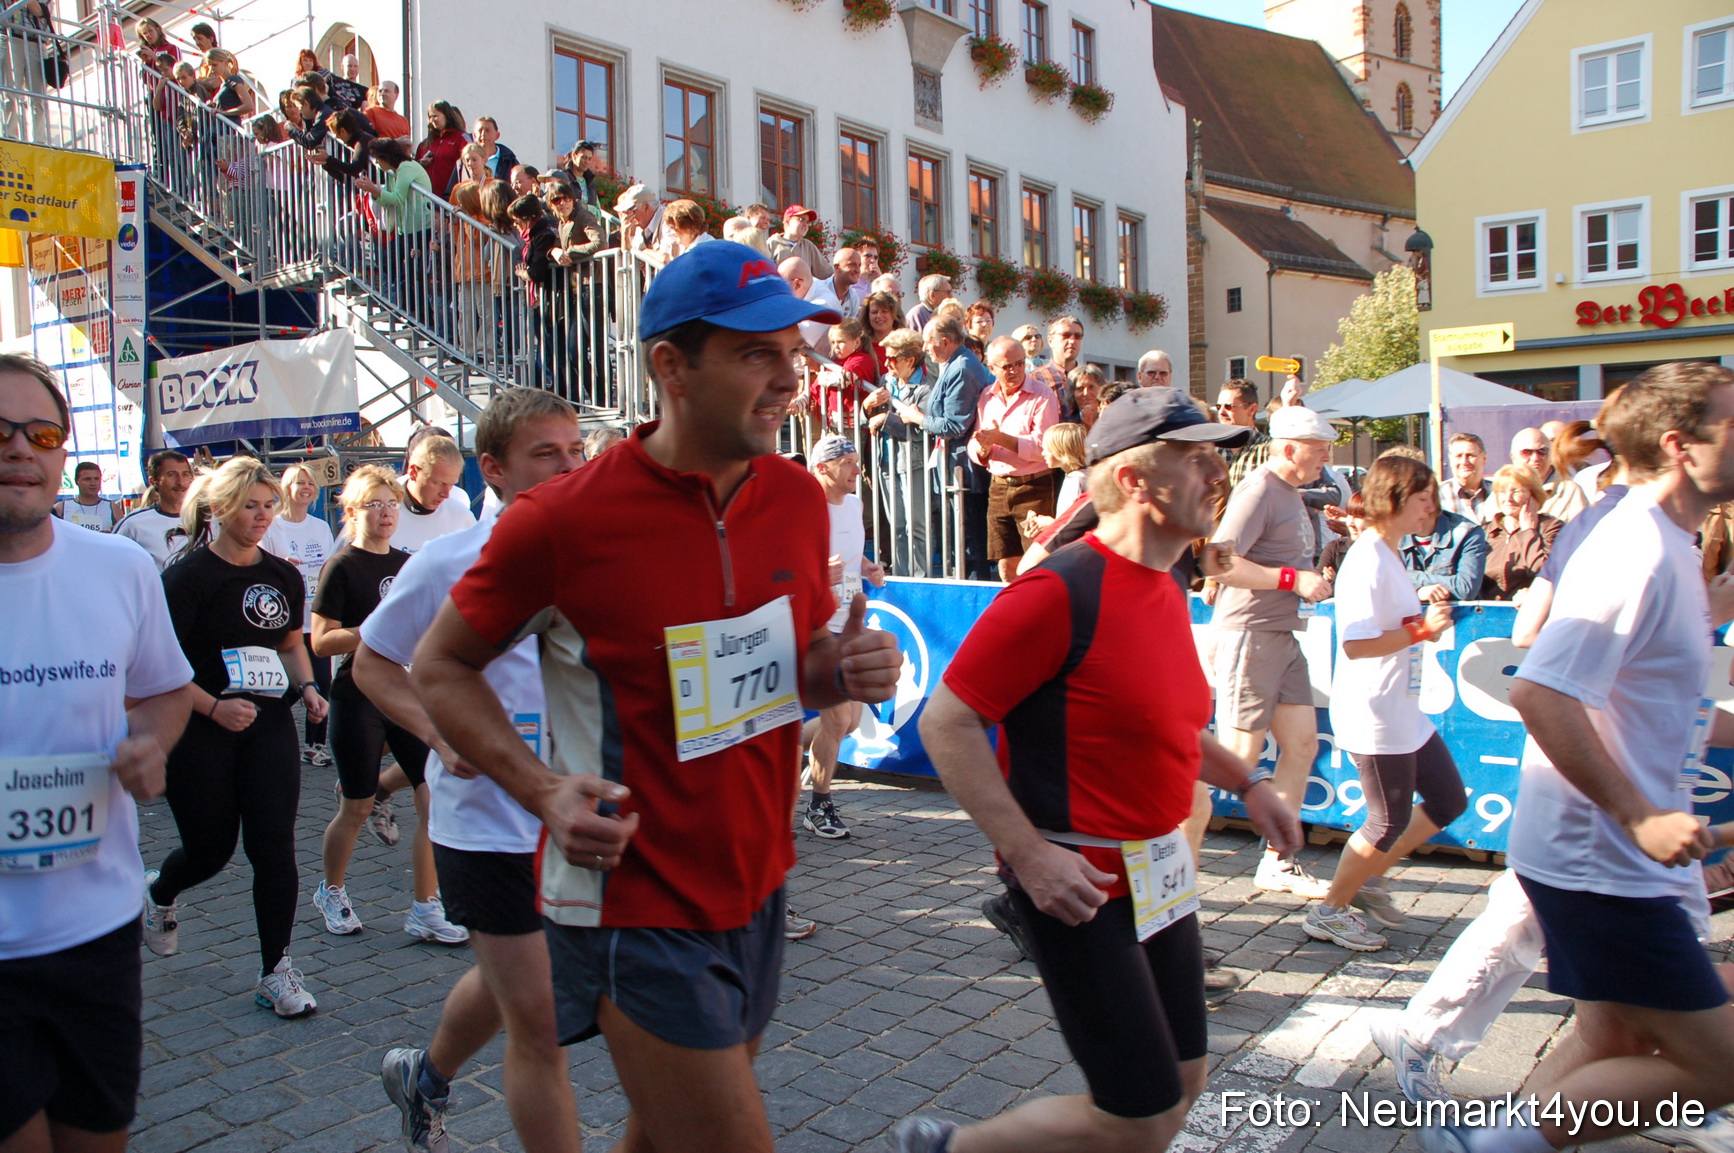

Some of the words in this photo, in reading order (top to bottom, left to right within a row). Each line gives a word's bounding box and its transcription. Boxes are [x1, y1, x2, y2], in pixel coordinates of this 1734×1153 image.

[14, 191, 79, 210] Stadtlauf
[61, 286, 87, 301] MERZ
[1576, 300, 1634, 327] Der
[159, 361, 259, 415] BOCK
[715, 627, 770, 659] Jürgen
[242, 651, 271, 663] Tamara
[0, 660, 117, 687] bodyswife.de
[247, 671, 284, 687] 3172
[730, 660, 780, 709] 770
[6, 767, 85, 791] Joachim
[7, 803, 95, 841] 3301
